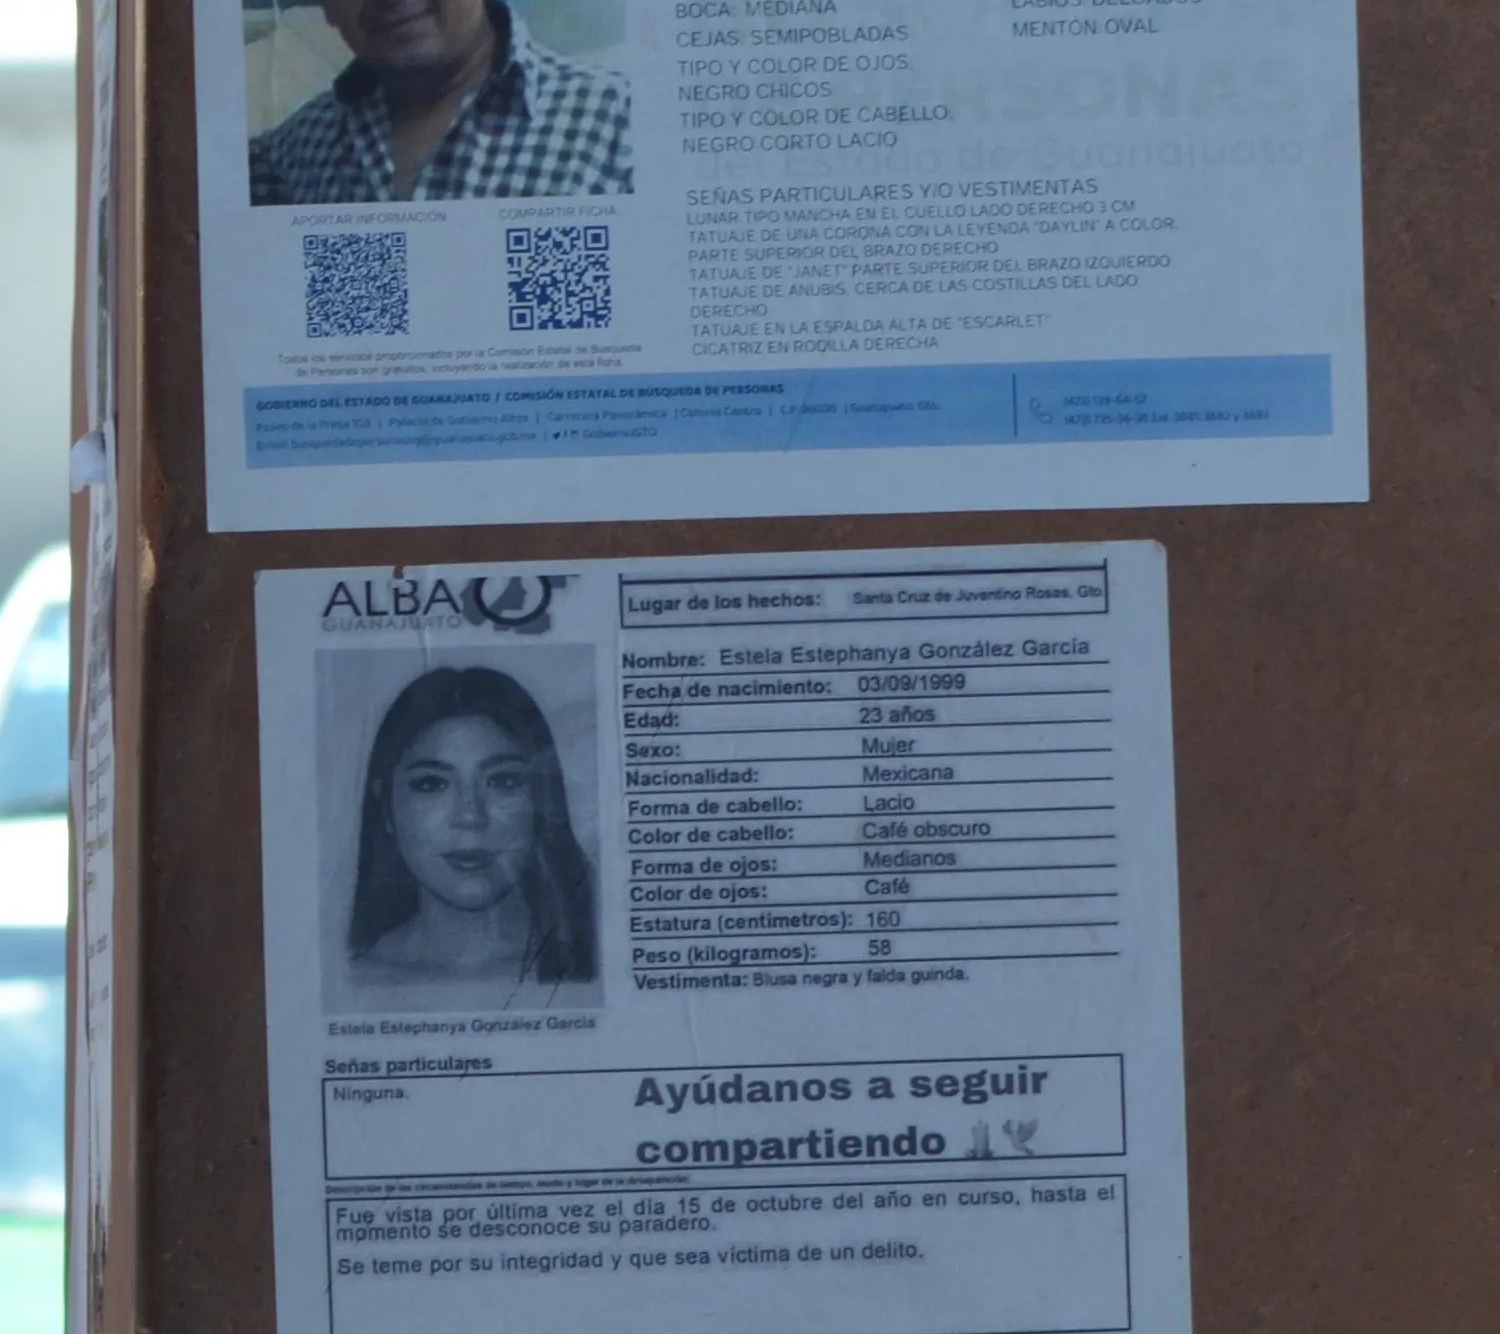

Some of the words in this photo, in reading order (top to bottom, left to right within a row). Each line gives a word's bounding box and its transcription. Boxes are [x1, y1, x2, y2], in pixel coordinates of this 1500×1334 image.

[678, 84, 751, 102] NEGRO
[756, 81, 833, 100] CHICOS
[686, 187, 755, 206] SEÑAS
[760, 184, 914, 203] PARTICULARES
[919, 182, 953, 199] Y/O
[958, 178, 1099, 198] VESTIMENTAS
[322, 579, 463, 618] ALBA
[628, 597, 683, 616] Lugar
[687, 595, 710, 611] de
[714, 594, 743, 610] los
[747, 593, 821, 609] hechos:
[853, 592, 894, 605] Santa
[897, 590, 932, 604] Cruz
[934, 590, 953, 603] de
[955, 588, 1022, 602] Juventino
[622, 652, 706, 670] Nombre:
[720, 648, 783, 666] Estela
[790, 646, 911, 666] Estephanya
[918, 641, 1015, 660] González
[1021, 638, 1090, 657] García
[623, 683, 682, 700] Fecha
[686, 682, 712, 698] de
[718, 680, 833, 697] nacimiento:
[858, 673, 966, 693] 03/09/1999
[624, 712, 680, 729] Edad:
[859, 707, 883, 725] 23
[889, 705, 936, 723] años
[626, 742, 681, 759] Sexo:
[862, 738, 916, 756] Mujer
[626, 768, 759, 787] Nacionalidad:
[863, 766, 955, 782] Mexicana
[628, 800, 691, 817] Forma
[696, 798, 721, 815] de
[726, 797, 803, 814] cabello:
[864, 794, 916, 813] Lacio
[628, 828, 683, 845] Color
[687, 827, 712, 844] de
[716, 825, 794, 842] cabello:
[862, 821, 908, 840] Café
[913, 821, 992, 838] obscuro
[631, 859, 694, 876] Forma
[699, 857, 724, 874] de
[729, 856, 777, 876] ojos:
[863, 851, 957, 868] Medianos
[630, 885, 685, 903] Color
[689, 884, 714, 901] de
[718, 884, 768, 904] ojos:
[864, 877, 910, 896] Café
[630, 917, 712, 933] Estatura
[867, 910, 901, 928] 160
[632, 948, 682, 964] Peso
[687, 944, 820, 965] (kilogramos):
[869, 939, 892, 957] 58
[633, 973, 748, 990] Vestimenta:
[753, 972, 798, 987] Blusa
[802, 973, 849, 988] negra
[853, 972, 863, 988] y
[867, 968, 906, 983] falda
[911, 967, 970, 985] guinda.
[325, 1059, 381, 1074] Señas
[386, 1057, 493, 1074] particulares
[333, 1087, 410, 1104] Ninguna.
[630, 1070, 853, 1111] Ayúdanos
[867, 1076, 896, 1101] a
[909, 1065, 1049, 1105] seguir
[636, 1128, 948, 1166] compartiendo
[337, 1258, 366, 1276] Se
[372, 1259, 423, 1275] teme
[430, 1258, 464, 1277] por
[469, 1257, 494, 1272] su
[501, 1252, 604, 1273] integridad
[610, 1254, 623, 1271] y
[629, 1252, 668, 1270] que
[674, 1251, 711, 1266] sea
[717, 1246, 791, 1264] víctima
[797, 1244, 823, 1263] de
[830, 1246, 855, 1261] un
[861, 1242, 924, 1260] delito.
